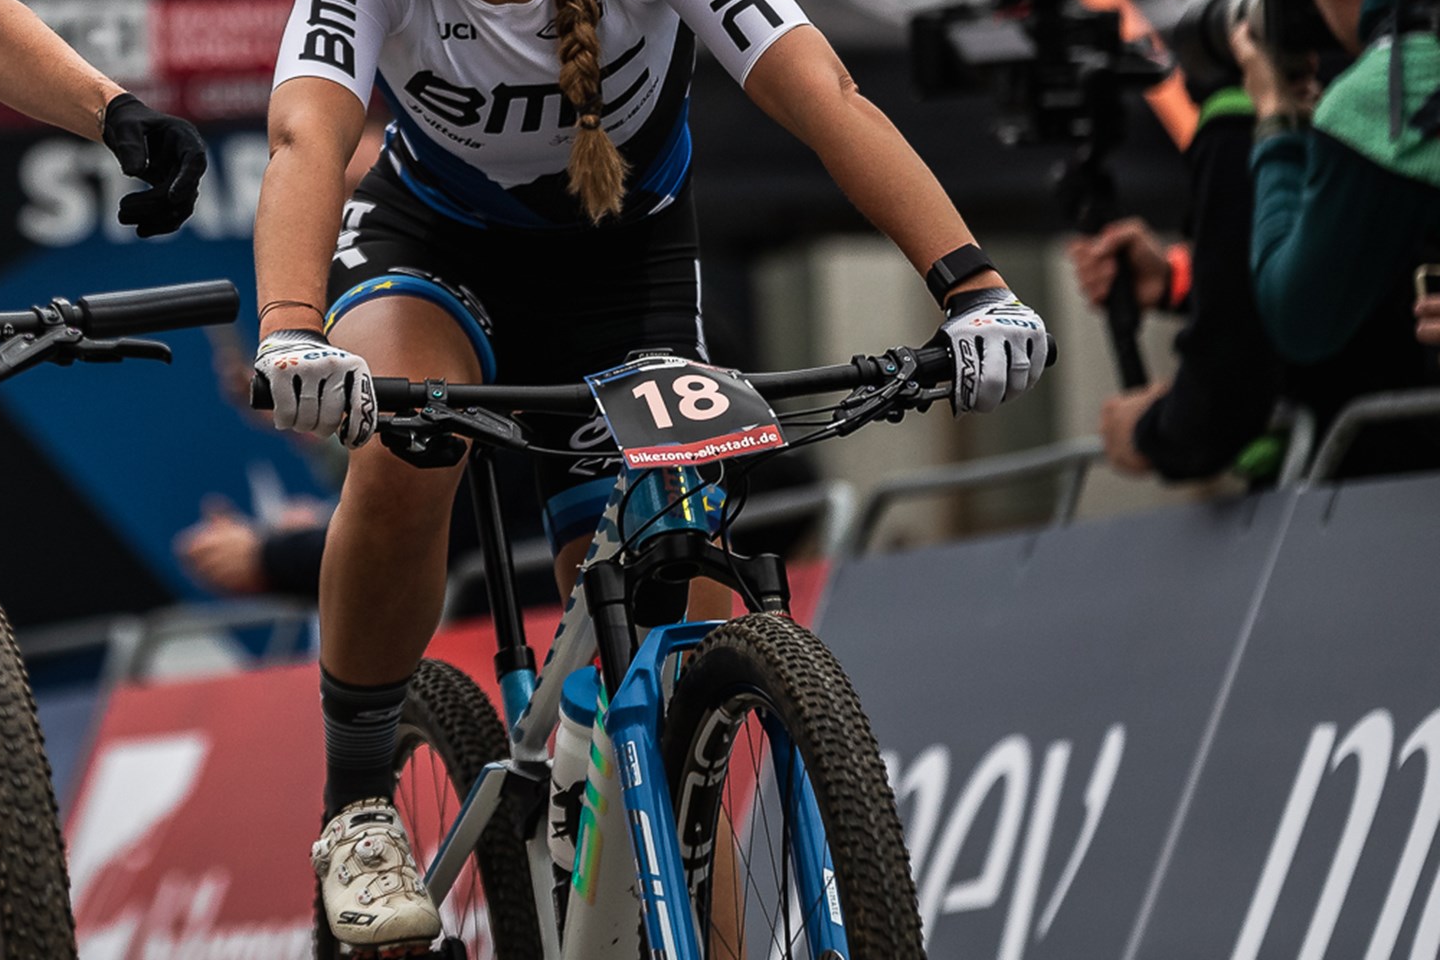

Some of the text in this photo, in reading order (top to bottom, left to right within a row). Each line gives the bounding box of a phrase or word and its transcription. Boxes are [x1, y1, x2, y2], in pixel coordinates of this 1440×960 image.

[404, 35, 651, 135] BMC
[632, 374, 730, 429] 18
[629, 432, 779, 464] bikezone-albstadt.de
